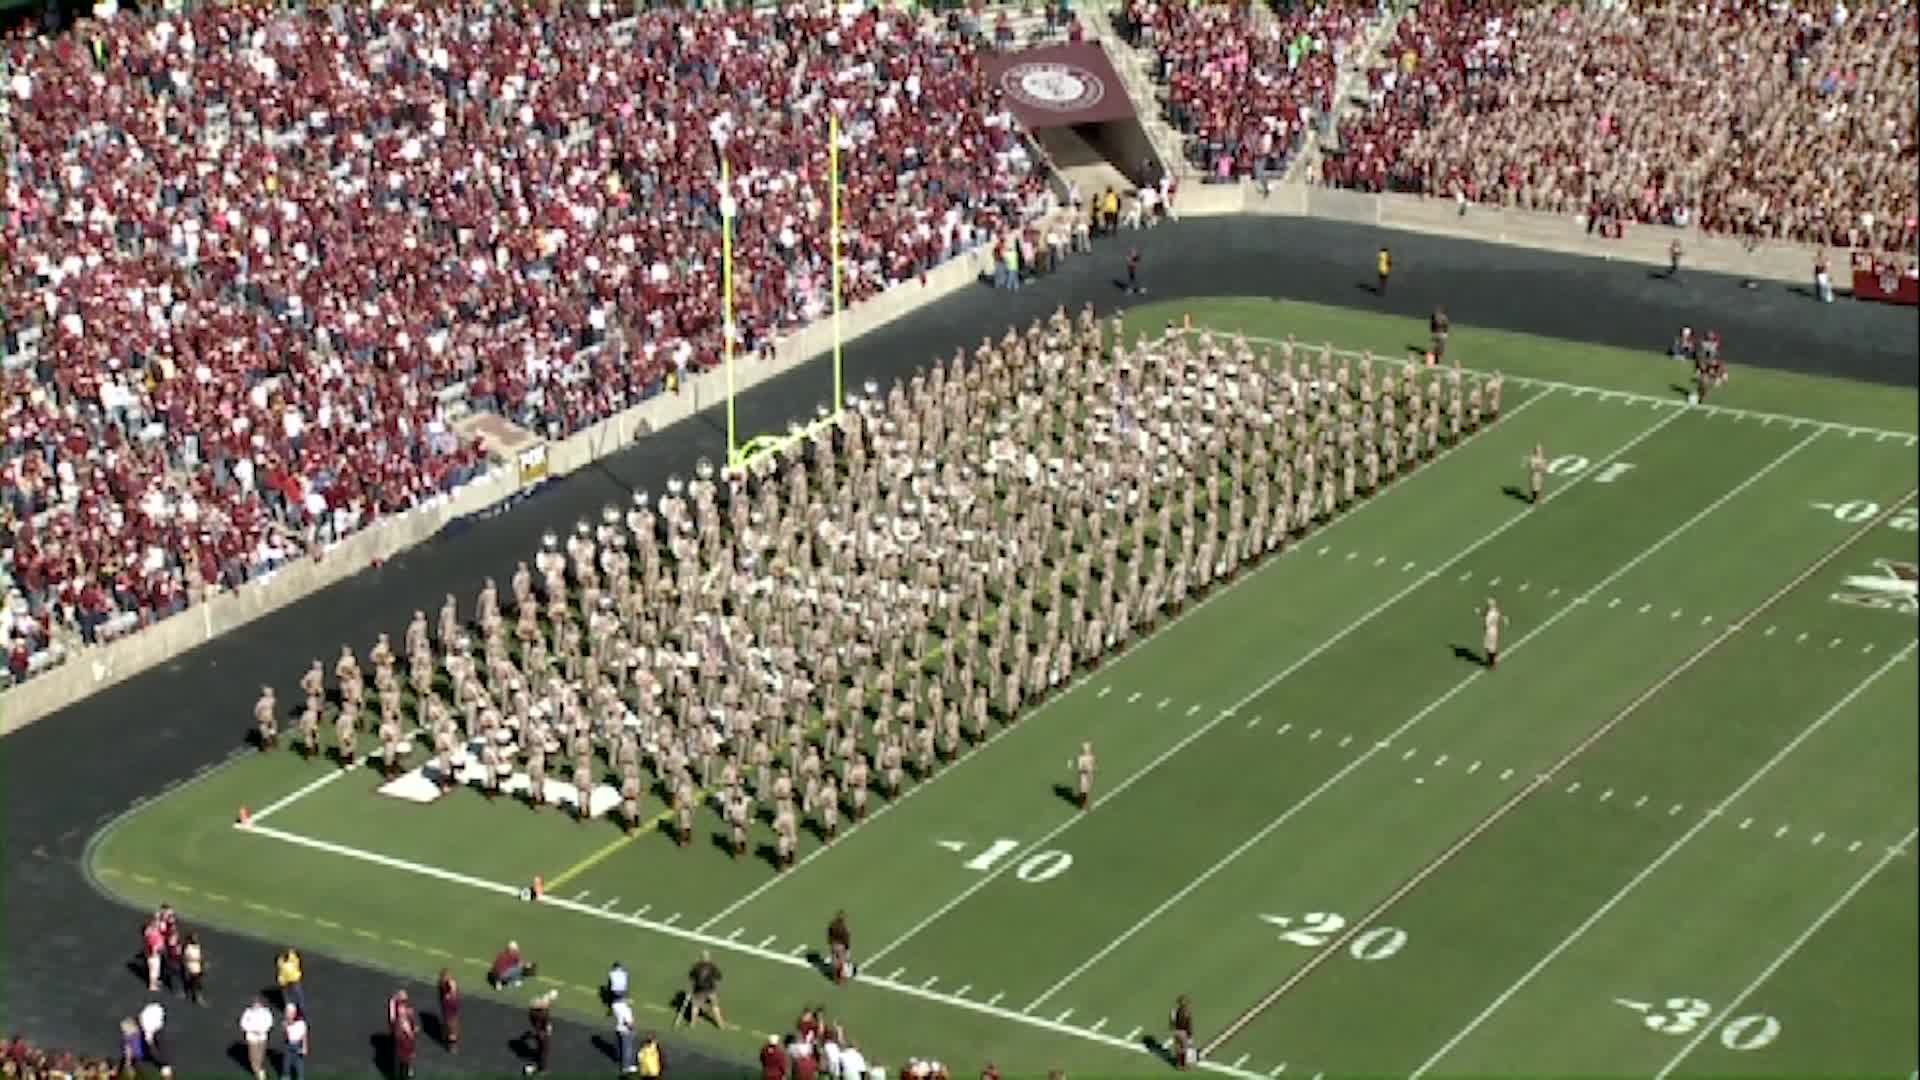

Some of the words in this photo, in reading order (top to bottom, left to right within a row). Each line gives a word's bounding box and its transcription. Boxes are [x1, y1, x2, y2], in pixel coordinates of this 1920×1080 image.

[1547, 454, 1636, 482] 10
[963, 840, 1073, 882] 10
[1278, 912, 1408, 959] 20
[1645, 998, 1781, 1049] 30
